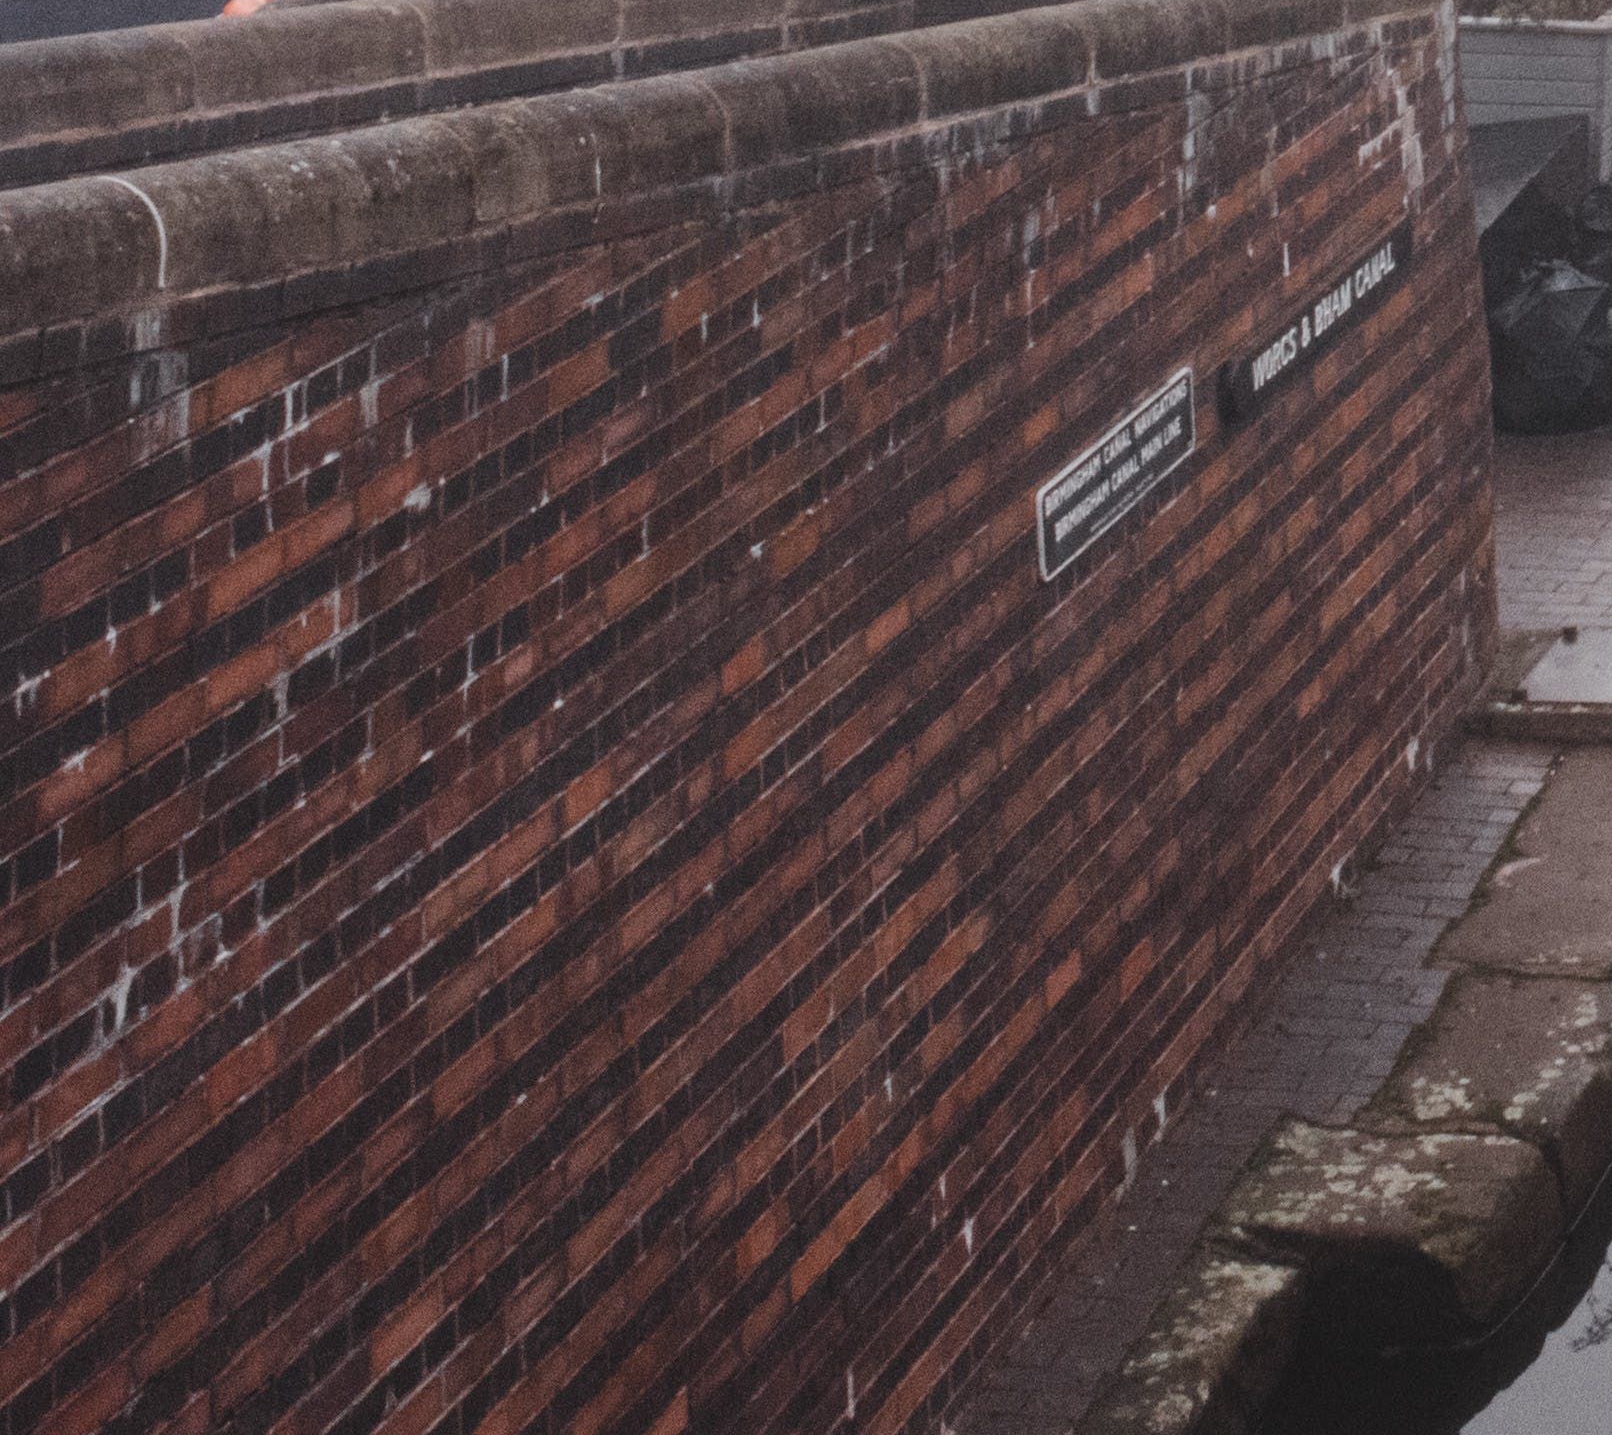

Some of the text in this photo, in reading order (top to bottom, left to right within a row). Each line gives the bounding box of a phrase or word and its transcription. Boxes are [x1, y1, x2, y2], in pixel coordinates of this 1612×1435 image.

[1252, 241, 1396, 392] WORCS & BHAM CANAL
[1045, 452, 1101, 517] BIRMINGHAM
[1103, 427, 1132, 464] CANAL
[1134, 378, 1188, 439] NAVIGATIONS
[1055, 478, 1111, 542] BIRMINGHAM
[1111, 454, 1141, 492] CANAL
[1141, 432, 1163, 466] MAIN
[1163, 415, 1182, 447] LINE
